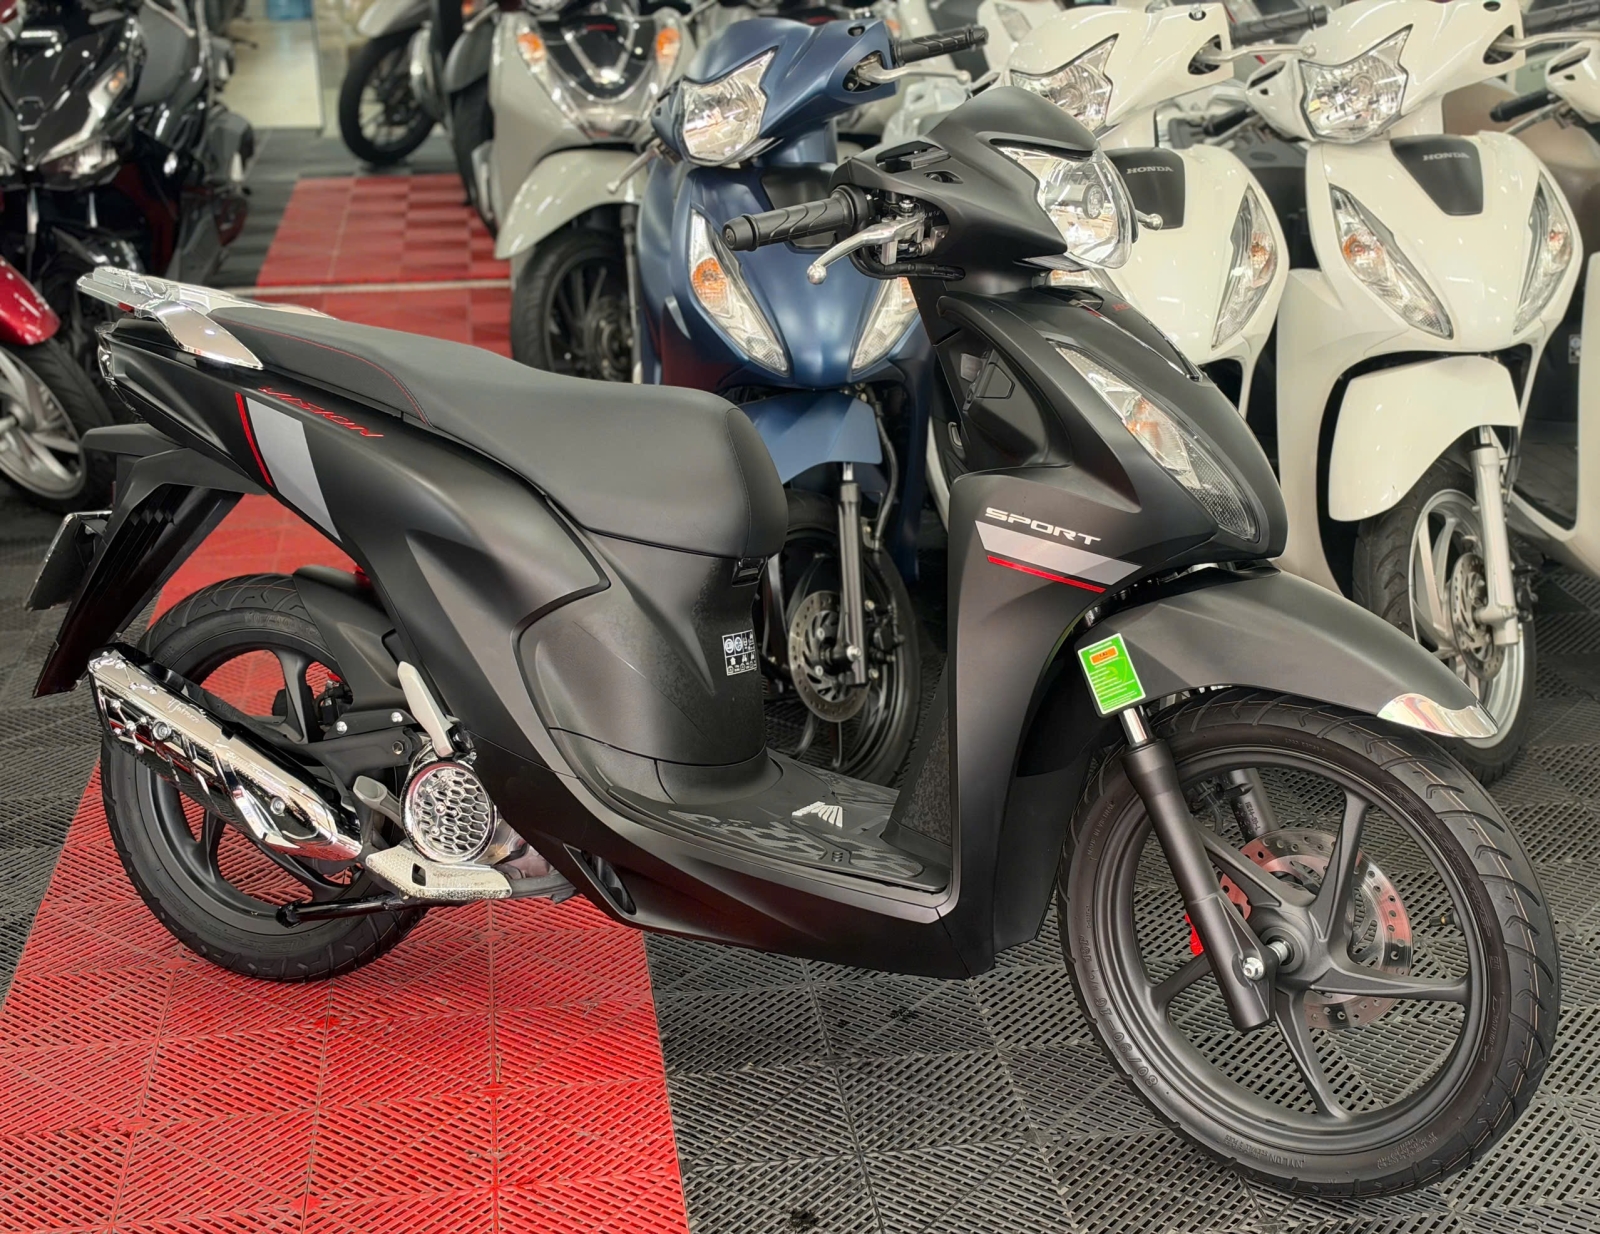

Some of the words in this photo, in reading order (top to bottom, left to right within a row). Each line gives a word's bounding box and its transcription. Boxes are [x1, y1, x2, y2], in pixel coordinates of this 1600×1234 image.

[1422, 152, 1470, 161] HONDA
[1126, 166, 1174, 174] HONDA
[257, 386, 384, 437] VISION
[985, 506, 1101, 545] SPORT
